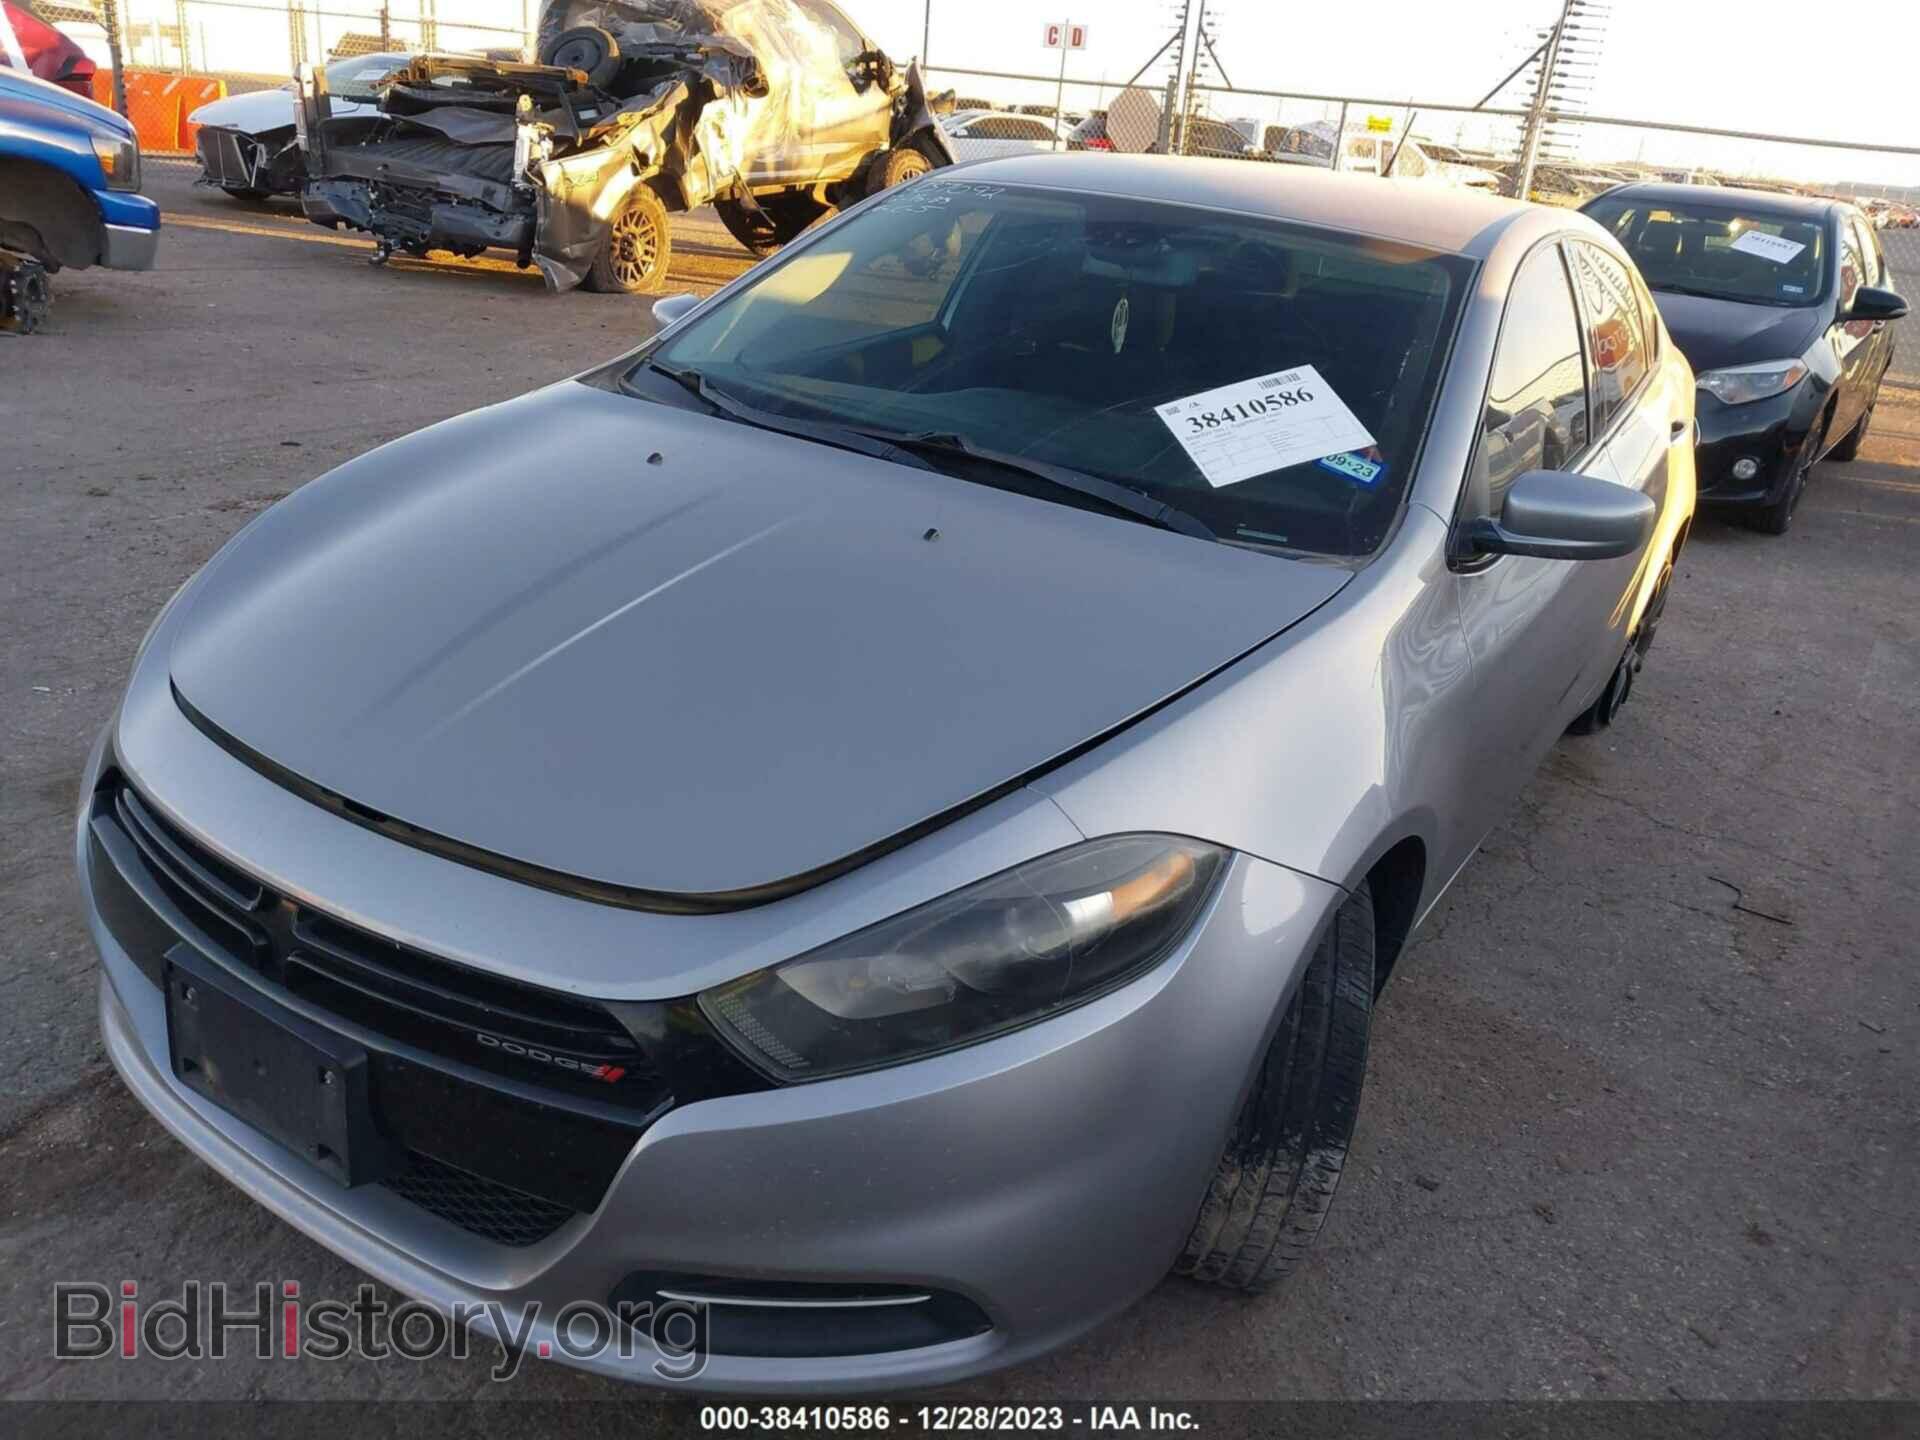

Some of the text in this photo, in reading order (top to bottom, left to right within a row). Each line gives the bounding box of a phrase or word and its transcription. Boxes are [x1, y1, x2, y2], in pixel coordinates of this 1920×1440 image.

[1048, 25, 1083, 47] C D
[1185, 385, 1315, 434] 38410586
[476, 1033, 606, 1079] DODGE
